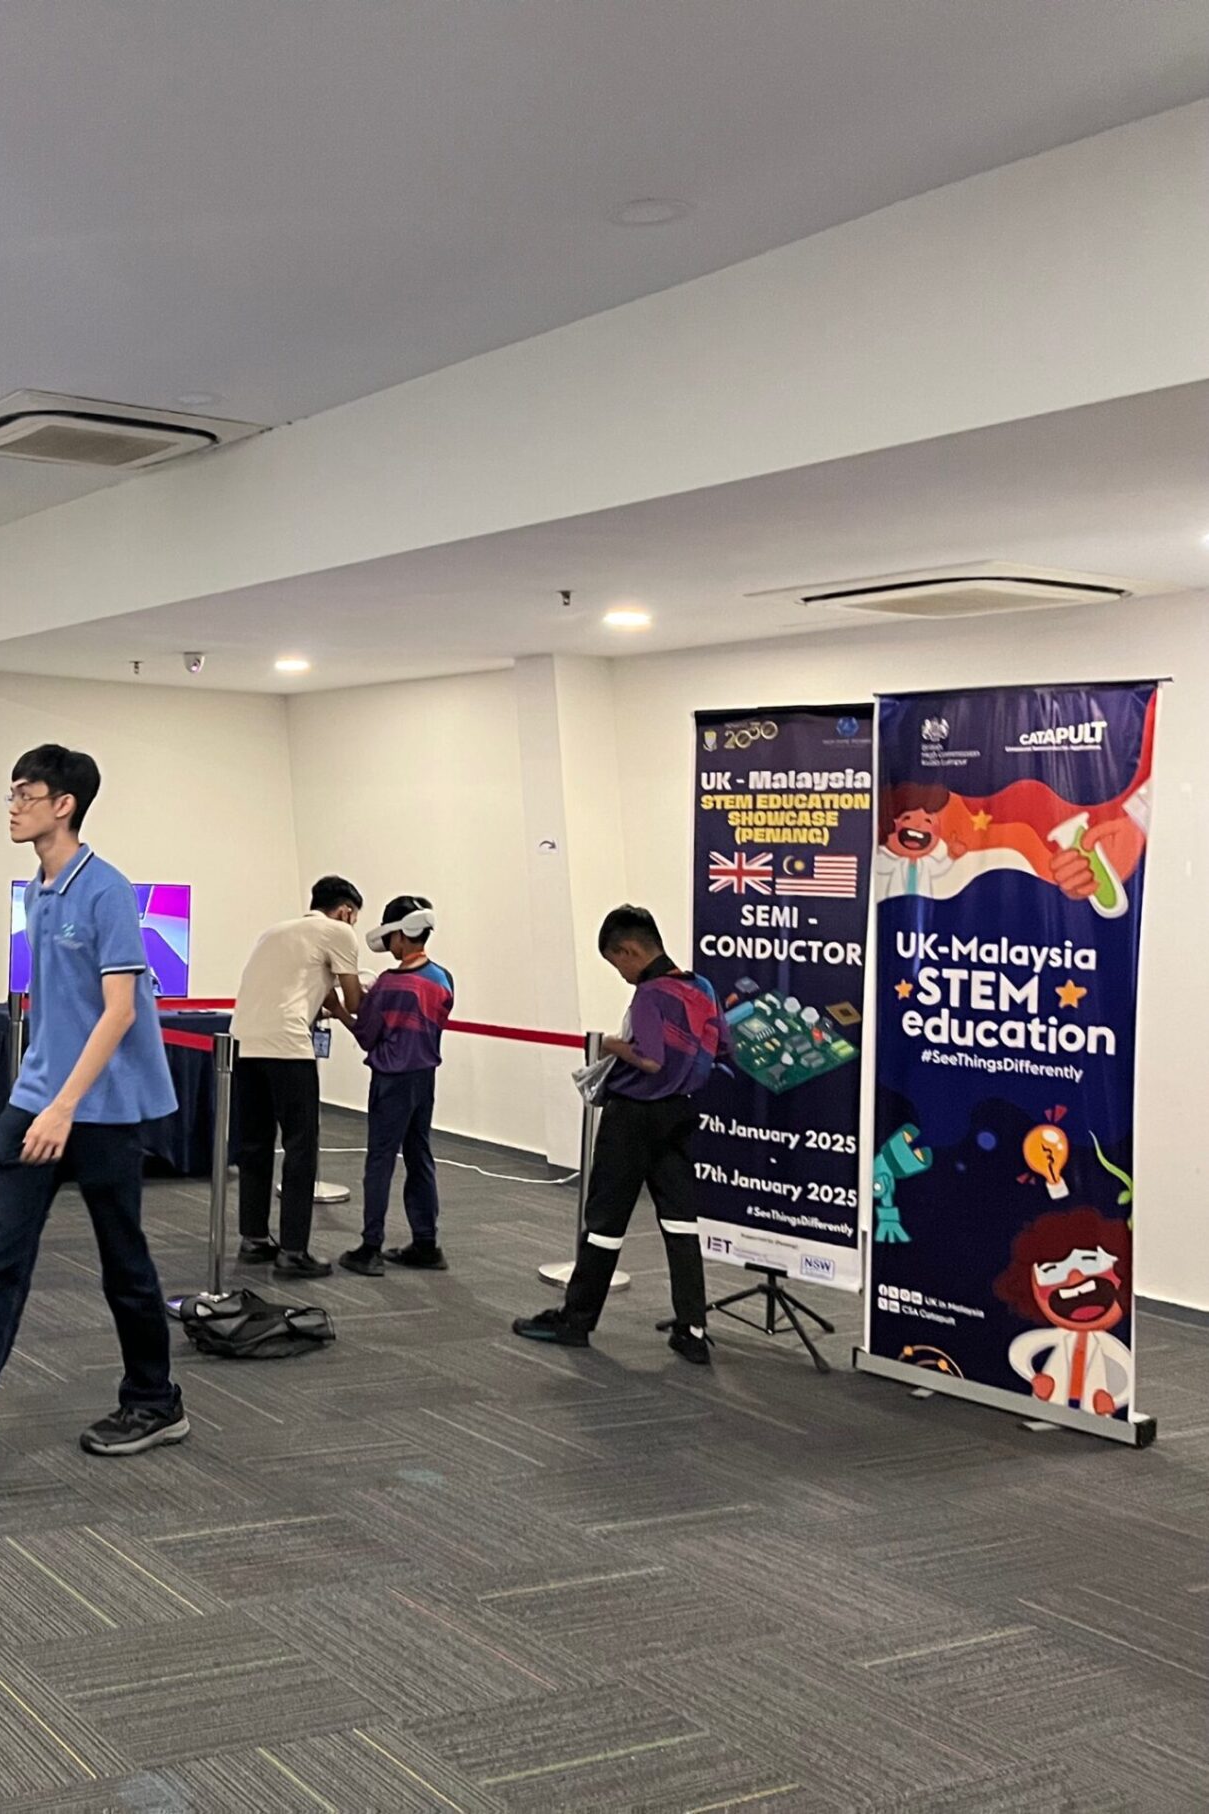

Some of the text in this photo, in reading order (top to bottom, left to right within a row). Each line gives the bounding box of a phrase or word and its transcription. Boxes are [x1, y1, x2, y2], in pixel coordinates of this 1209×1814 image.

[1020, 721, 1108, 745] CATAPULT
[701, 772, 731, 790] UK
[749, 769, 871, 791] Malaysia
[700, 794, 870, 810] STEM EDUCATION
[728, 811, 838, 827] SHOWCASE
[735, 827, 829, 846] (PENANG)
[741, 904, 798, 928] SEMI
[700, 935, 863, 966] CONDUCTOR
[896, 931, 1097, 972] UK-Malaysia
[917, 966, 1038, 1013] STEM
[901, 1009, 1116, 1055] education
[920, 1049, 1083, 1083] #SeeThingsDifferently
[698, 1113, 856, 1154] 7th January 2025
[694, 1162, 858, 1208] 17th January 2025
[746, 1206, 854, 1238] #SeeThingsDifferently
[707, 1236, 732, 1254] IET
[804, 1257, 831, 1272] NSW
